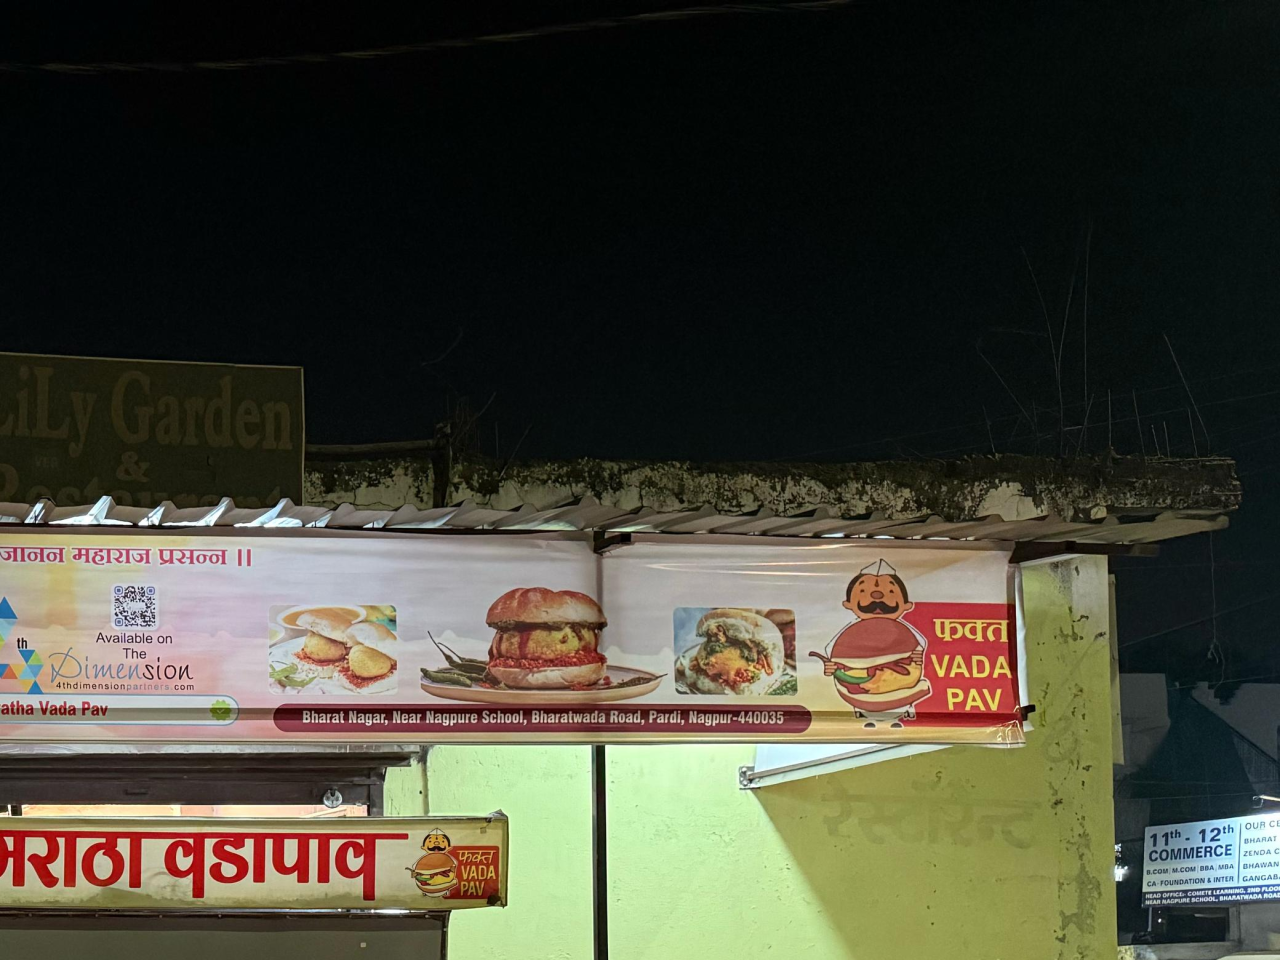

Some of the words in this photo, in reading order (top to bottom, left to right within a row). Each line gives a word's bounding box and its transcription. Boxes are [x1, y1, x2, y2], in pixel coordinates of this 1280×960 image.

[111, 370, 293, 450] Garden
[116, 451, 150, 483] &
[72, 546, 151, 567] महाराज
[159, 548, 227, 567] प्रसन्न
[96, 631, 153, 645] Available
[157, 634, 173, 645] on
[933, 617, 1010, 644] फक्त
[122, 648, 147, 660] The
[48, 647, 194, 684] Dimension
[931, 653, 1013, 680] VADA
[55, 681, 195, 691] 4thdimensionpartners.com
[947, 686, 1002, 712] PAV
[39, 701, 77, 716] Vada
[81, 702, 108, 718] Pav
[302, 710, 345, 724] Bharat
[348, 710, 389, 726] Nagar,
[392, 711, 422, 724] Near
[426, 711, 478, 727] Nagpure
[481, 710, 527, 726] School,
[531, 710, 606, 724] Bharatwada
[609, 710, 645, 726] Road,
[648, 711, 685, 726] Pardi,
[689, 711, 784, 727] Nagpur-440035
[1245, 821, 1266, 830] OUR
[1150, 829, 1181, 848] 11th
[1199, 824, 1234, 844] 12th
[1244, 835, 1277, 844] BHARAT
[1148, 843, 1233, 862] COMMERCE
[1243, 848, 1272, 857] ZENDA
[159, 830, 409, 901] वडापाव
[460, 867, 497, 881] VADA
[1146, 868, 1169, 876] B.COM
[1171, 866, 1196, 874] M.COM
[1213, 875, 1234, 883] INTER
[1242, 874, 1280, 882] GANGAB
[460, 882, 484, 897] PAV
